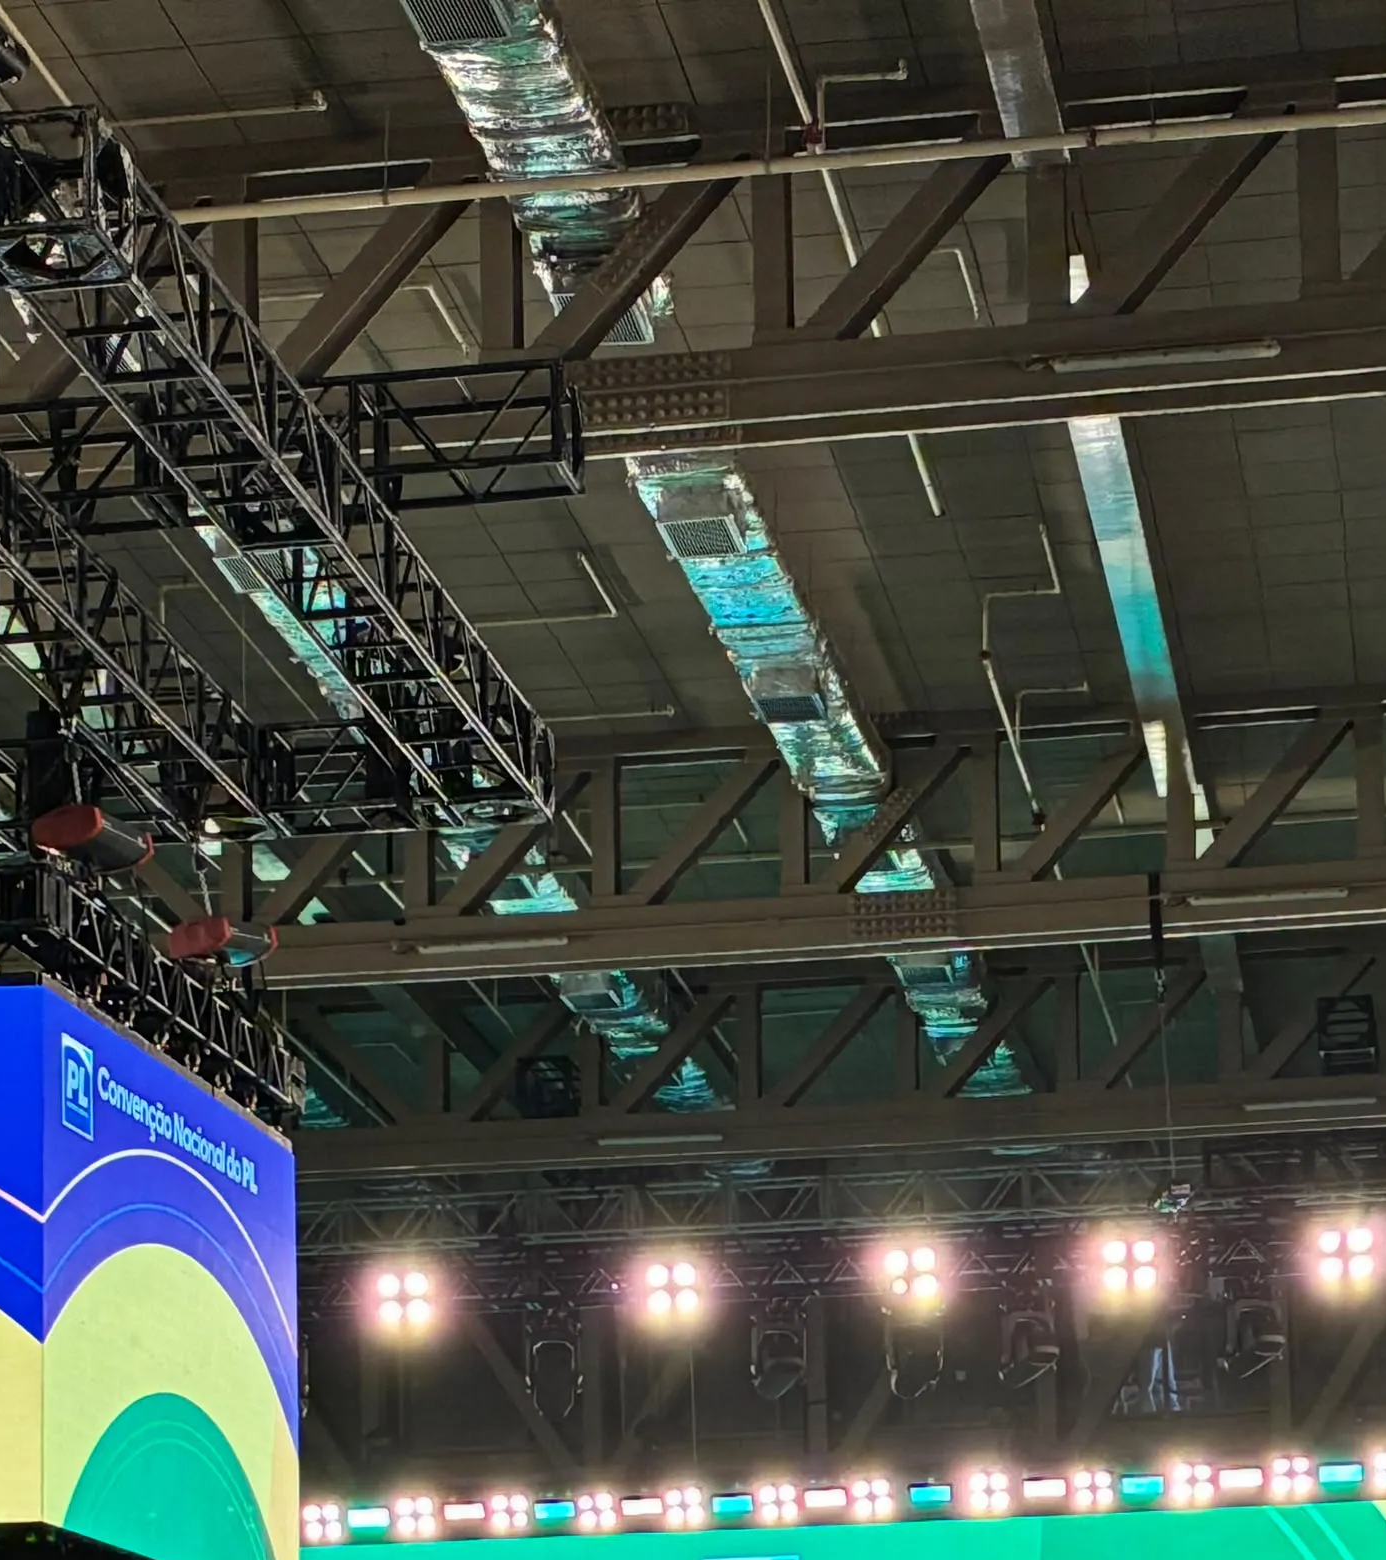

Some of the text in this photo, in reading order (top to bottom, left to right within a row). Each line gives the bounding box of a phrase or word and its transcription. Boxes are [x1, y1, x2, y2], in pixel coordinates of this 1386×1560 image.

[66, 1058, 89, 1109] PL
[97, 1066, 258, 1195] Convenção Nacional do PL
